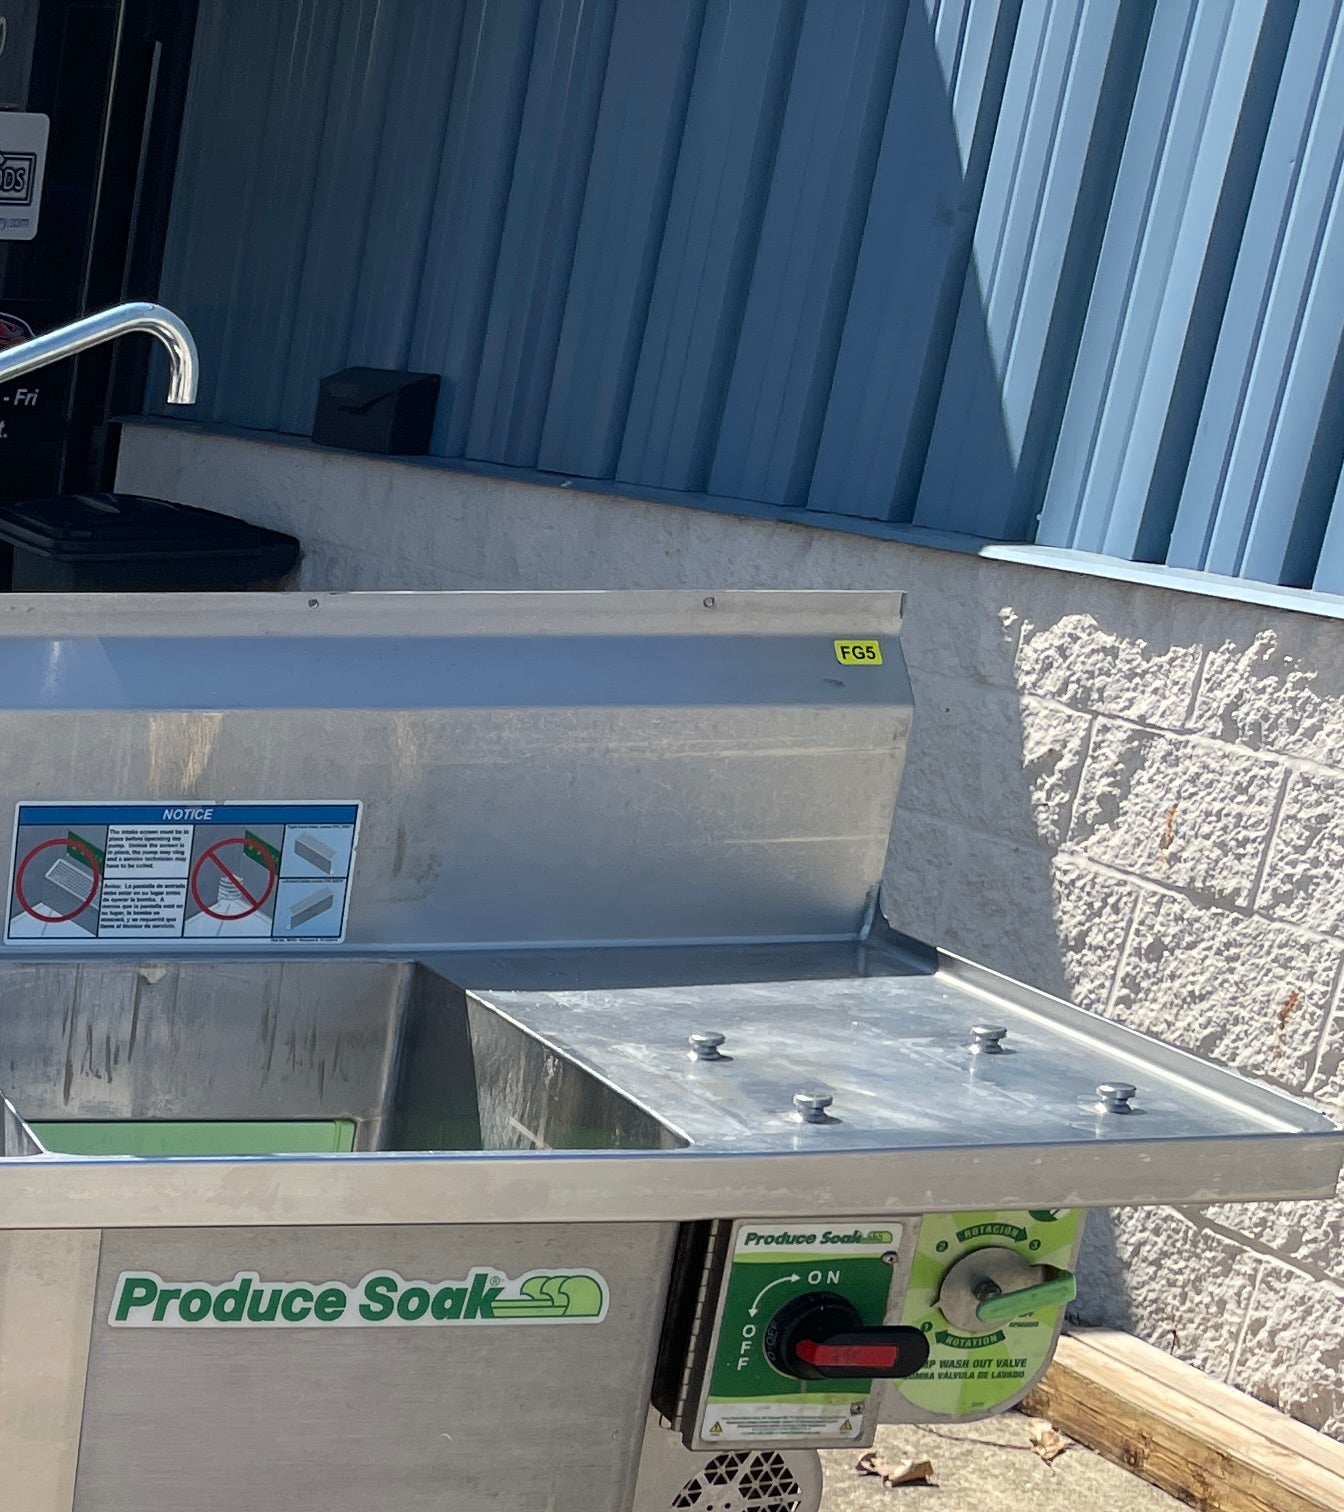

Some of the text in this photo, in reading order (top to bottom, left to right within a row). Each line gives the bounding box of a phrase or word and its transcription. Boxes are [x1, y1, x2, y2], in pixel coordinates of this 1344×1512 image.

[14, 388, 39, 406] Fri
[840, 646, 875, 659] FG5
[162, 808, 214, 820] NOTICE
[744, 1230, 863, 1246] Produce Soak
[808, 1270, 840, 1284] ON
[114, 1273, 505, 1322] Produce Soak
[737, 1324, 756, 1371] OFF
[946, 1334, 998, 1347] ROTATION
[940, 1360, 969, 1369] WASH
[972, 1359, 993, 1368] OUT
[996, 1358, 1028, 1368] VALVE
